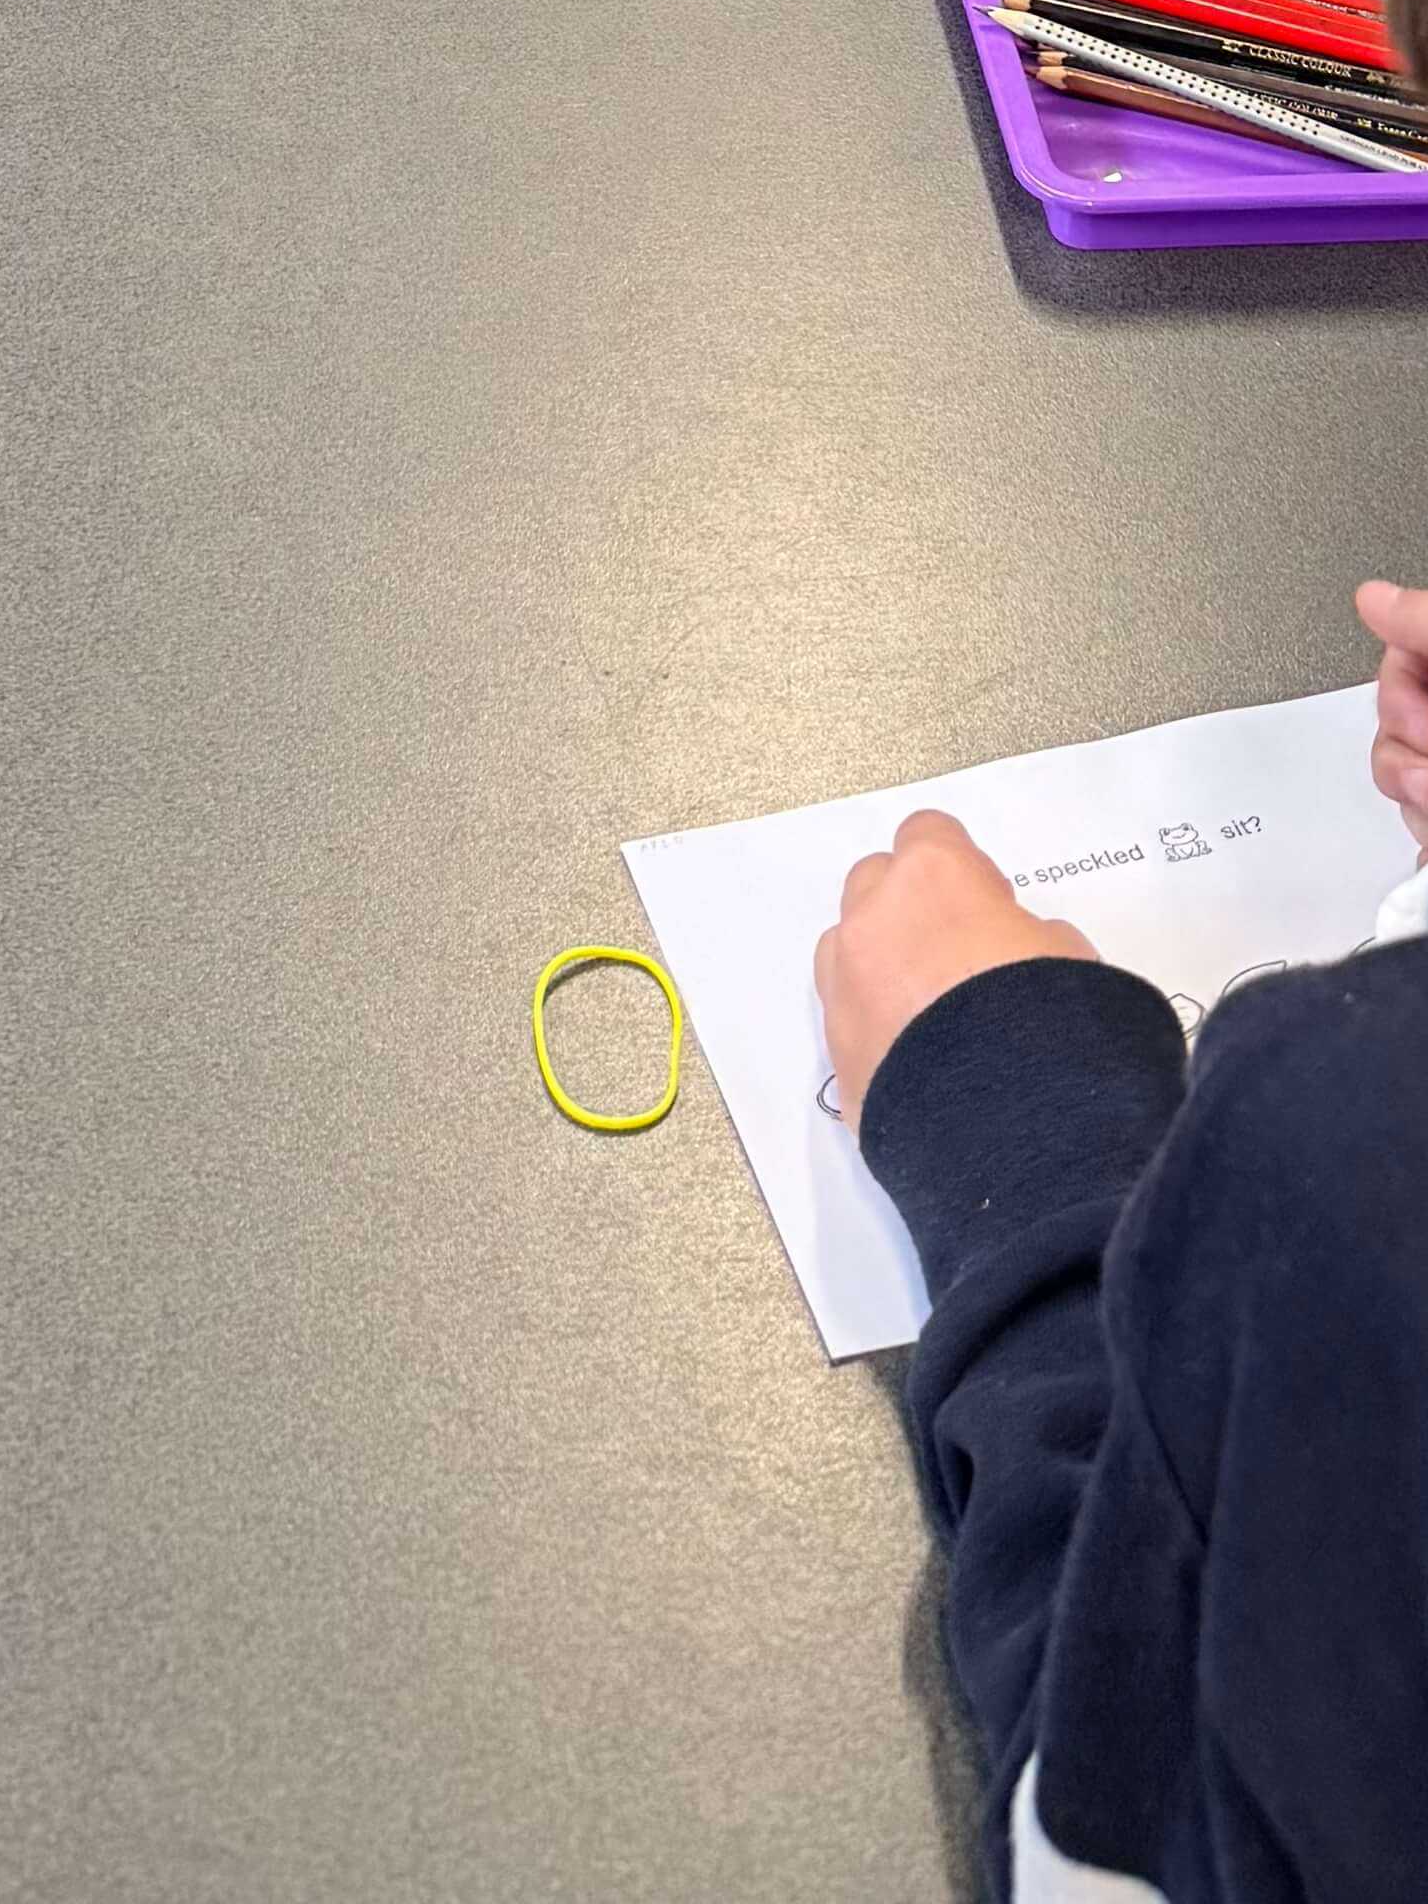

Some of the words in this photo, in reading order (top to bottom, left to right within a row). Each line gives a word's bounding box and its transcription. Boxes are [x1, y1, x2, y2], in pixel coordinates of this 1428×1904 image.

[1249, 45, 1299, 66] CLASSIC
[1302, 52, 1352, 78] COLOUR
[1035, 843, 1145, 883] speckled
[1220, 815, 1263, 840] sit?
